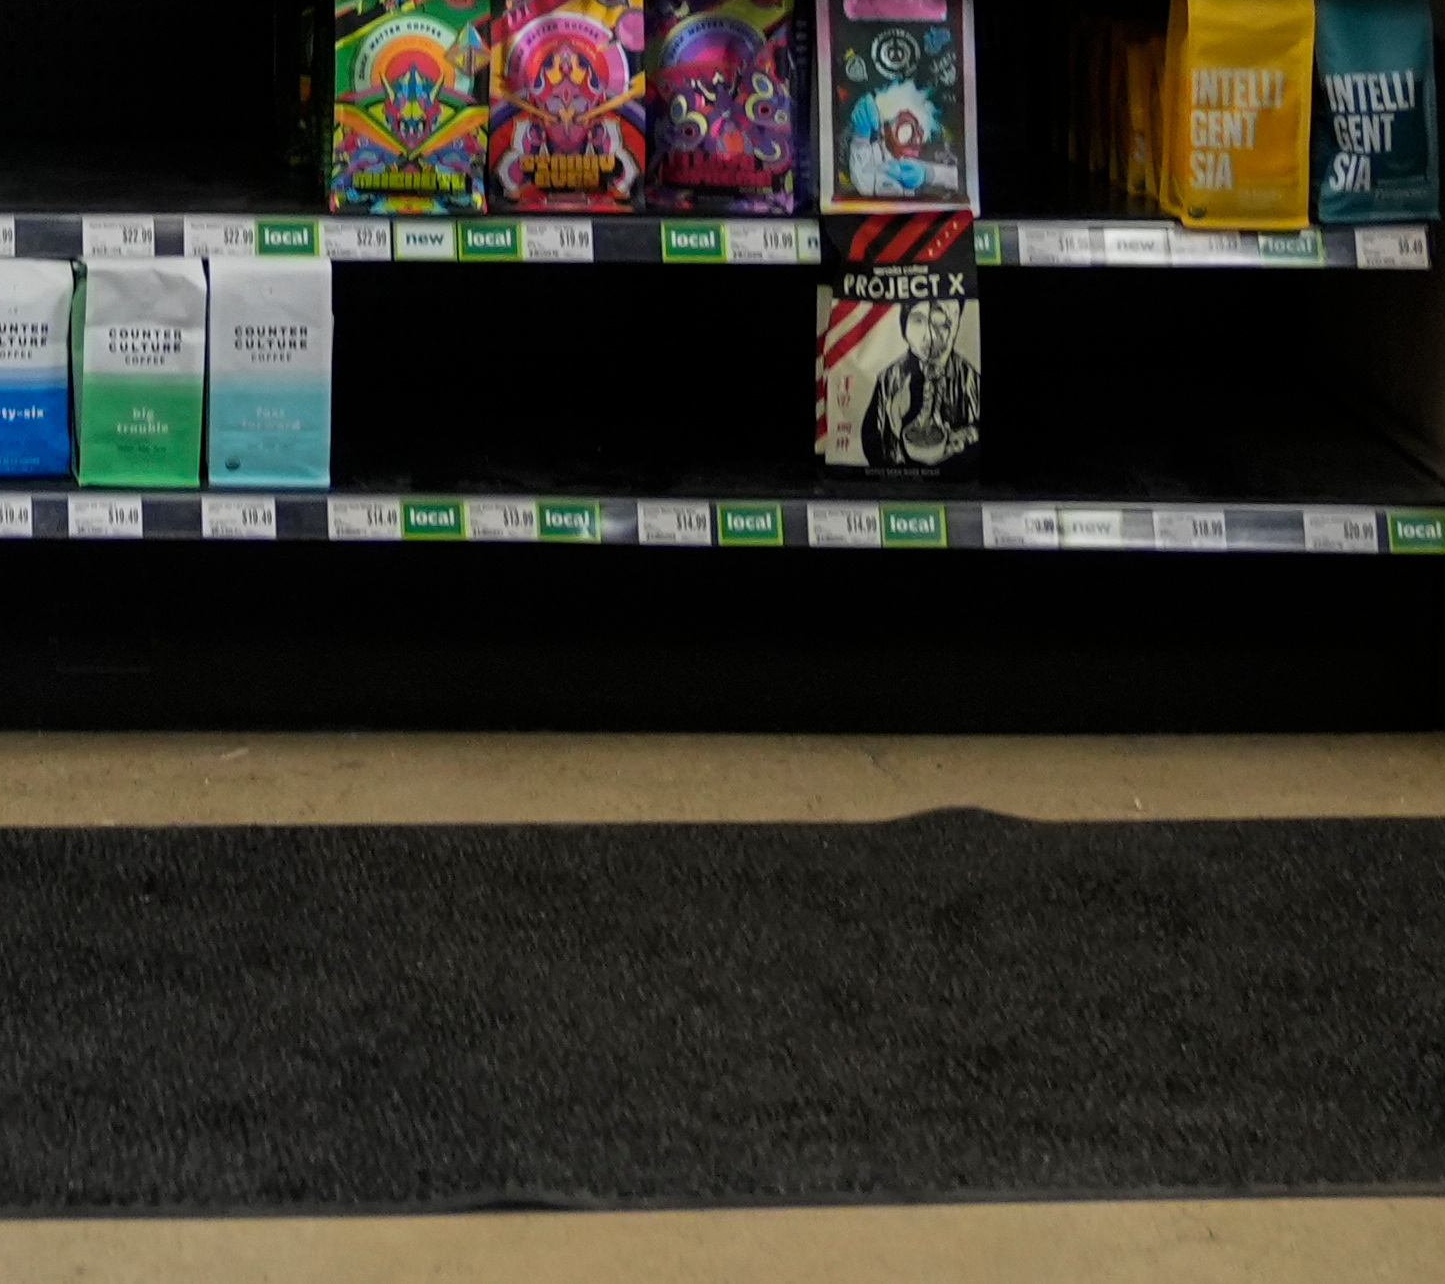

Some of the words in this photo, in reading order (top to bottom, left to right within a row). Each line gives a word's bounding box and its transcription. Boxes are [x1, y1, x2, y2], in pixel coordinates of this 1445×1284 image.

[1190, 68, 1284, 109] INTELLI
[1325, 72, 1415, 112] INTELLI
[1190, 110, 1256, 150] GENT
[1333, 113, 1395, 154] GENT
[1190, 151, 1233, 190] SIA
[1329, 156, 1371, 191] SIA
[843, 273, 941, 299] PROJECT
[948, 273, 964, 296] X
[110, 329, 182, 342] COUNTER
[110, 341, 181, 354] CULTURE
